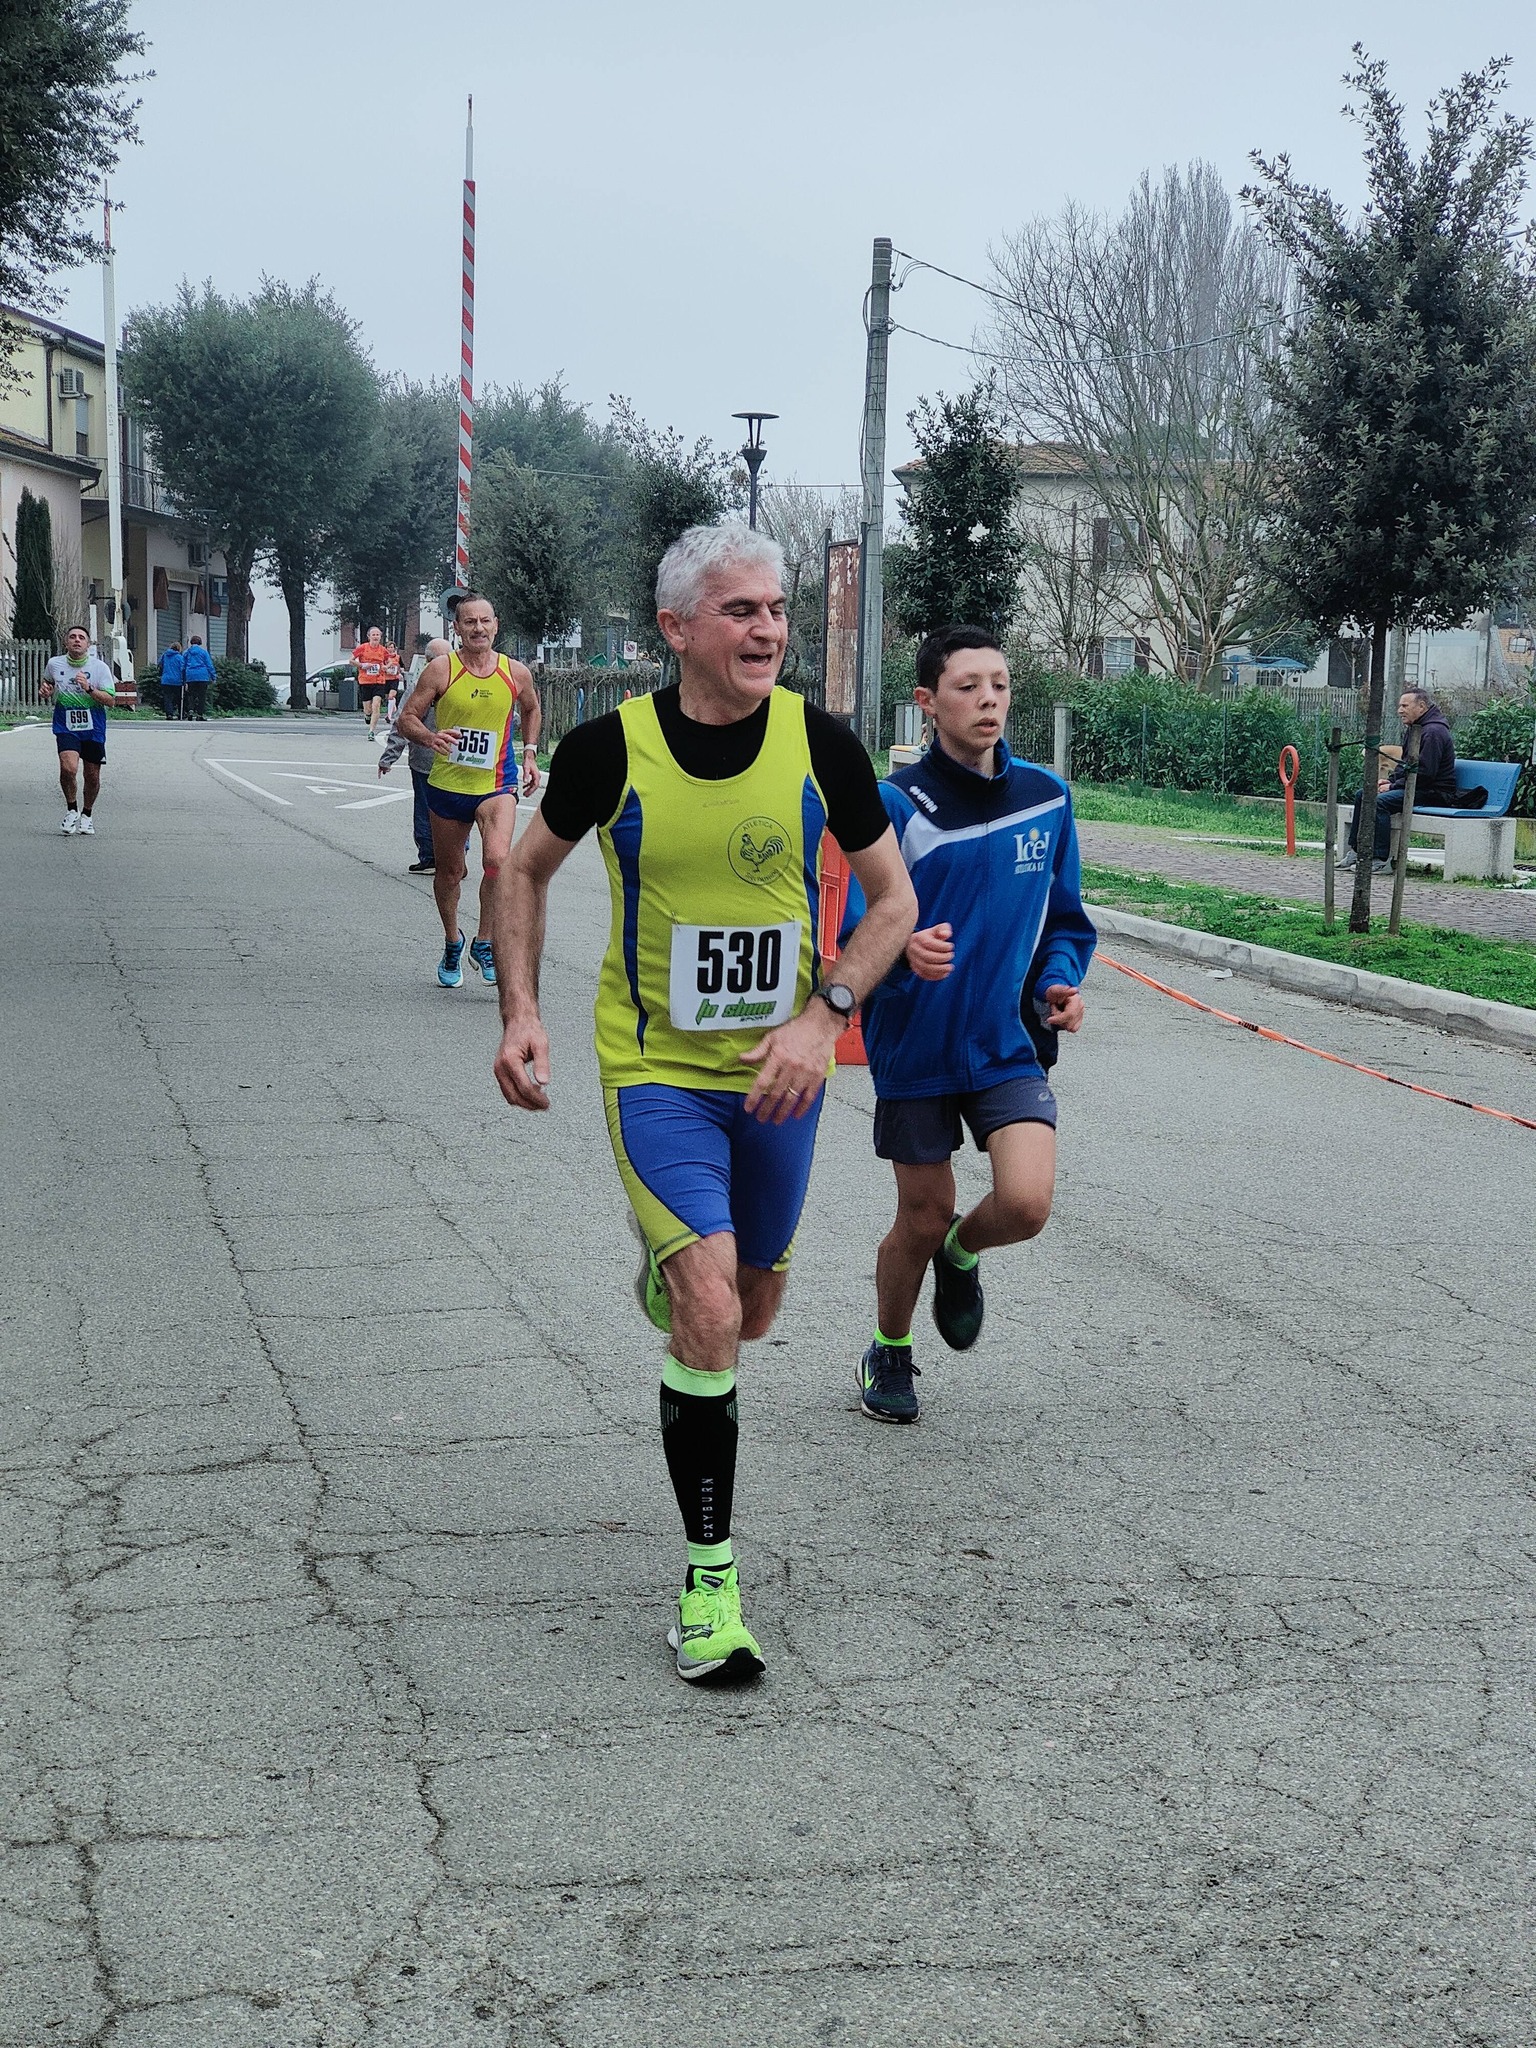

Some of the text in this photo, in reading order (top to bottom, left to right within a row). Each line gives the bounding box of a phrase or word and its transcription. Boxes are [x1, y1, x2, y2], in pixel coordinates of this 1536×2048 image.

[70, 710, 89, 724] 699
[458, 729, 490, 755] 555
[697, 929, 782, 994] 530
[701, 1478, 714, 1538] OXYBURN
